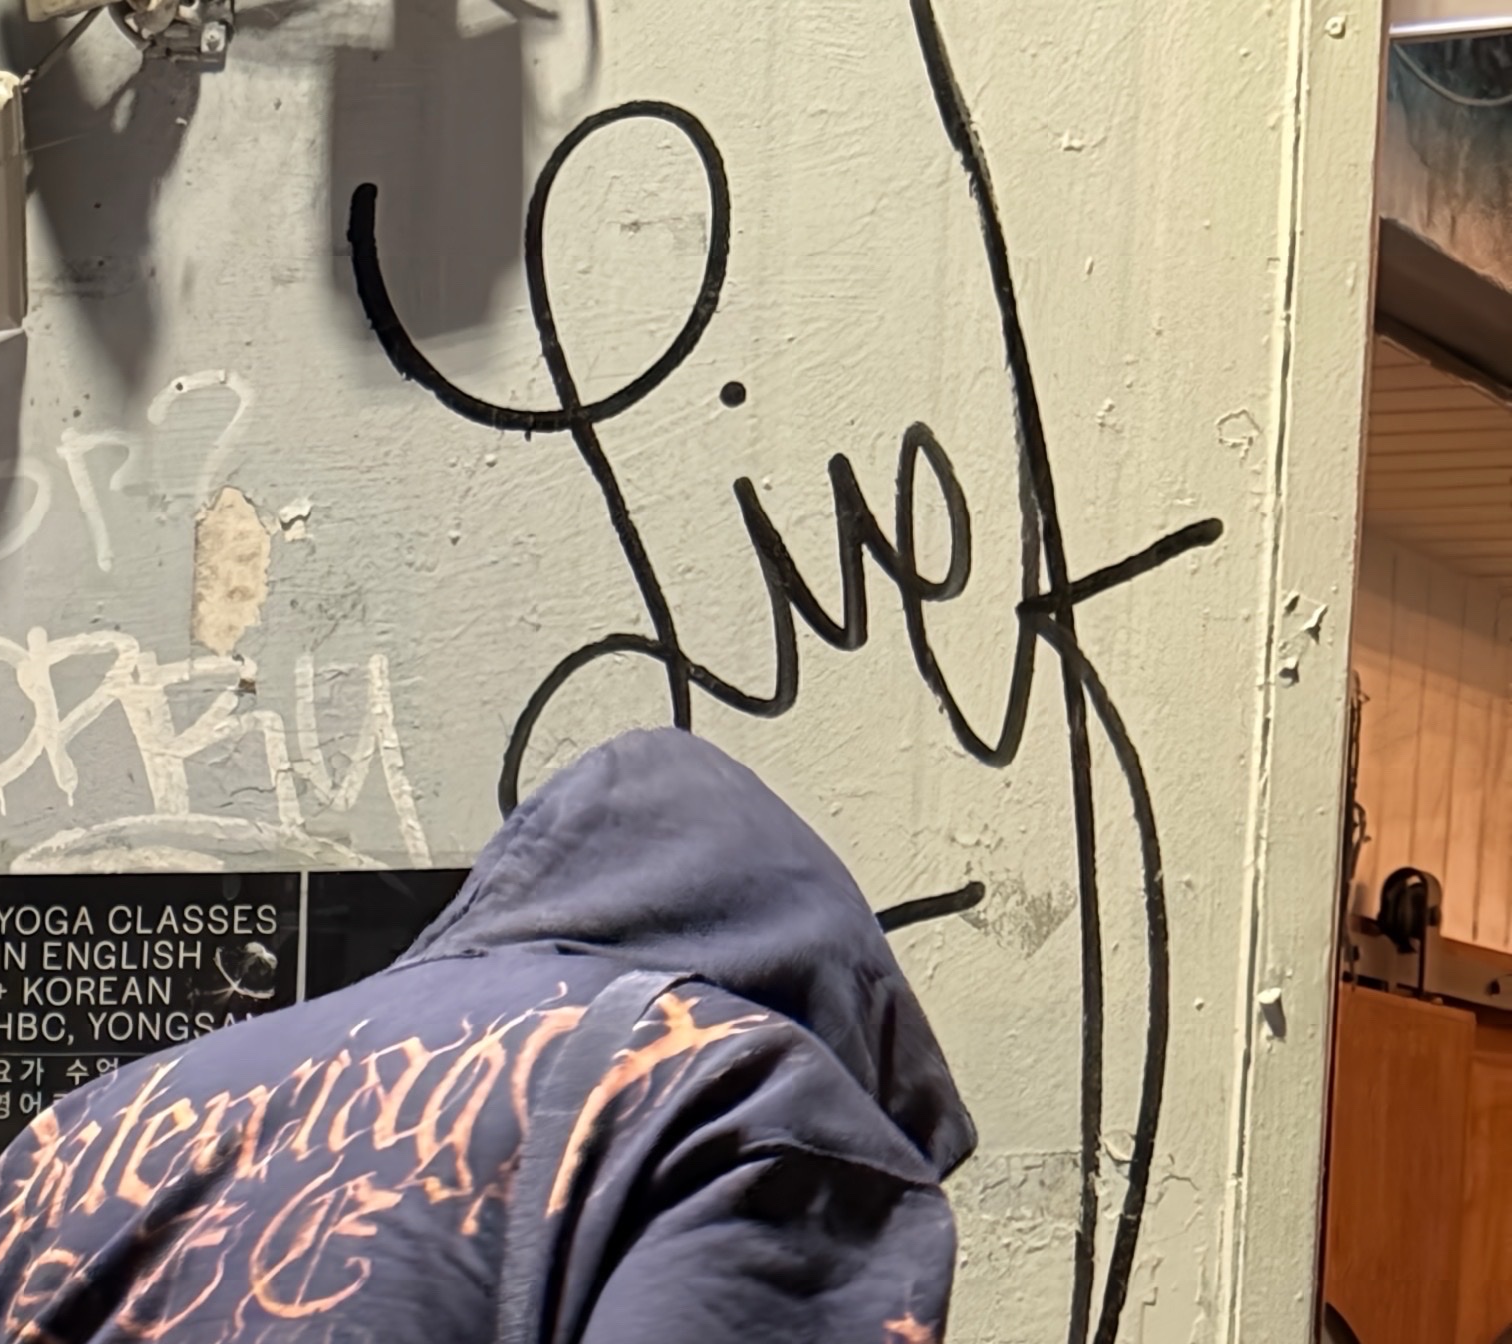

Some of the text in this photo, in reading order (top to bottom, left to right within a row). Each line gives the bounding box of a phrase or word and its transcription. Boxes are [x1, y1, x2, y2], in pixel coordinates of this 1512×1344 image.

[108, 905, 278, 935] CLASSES
[43, 941, 202, 970] ENGLISH
[22, 976, 172, 1006] KOREAN
[88, 1011, 254, 1041] YONGS
